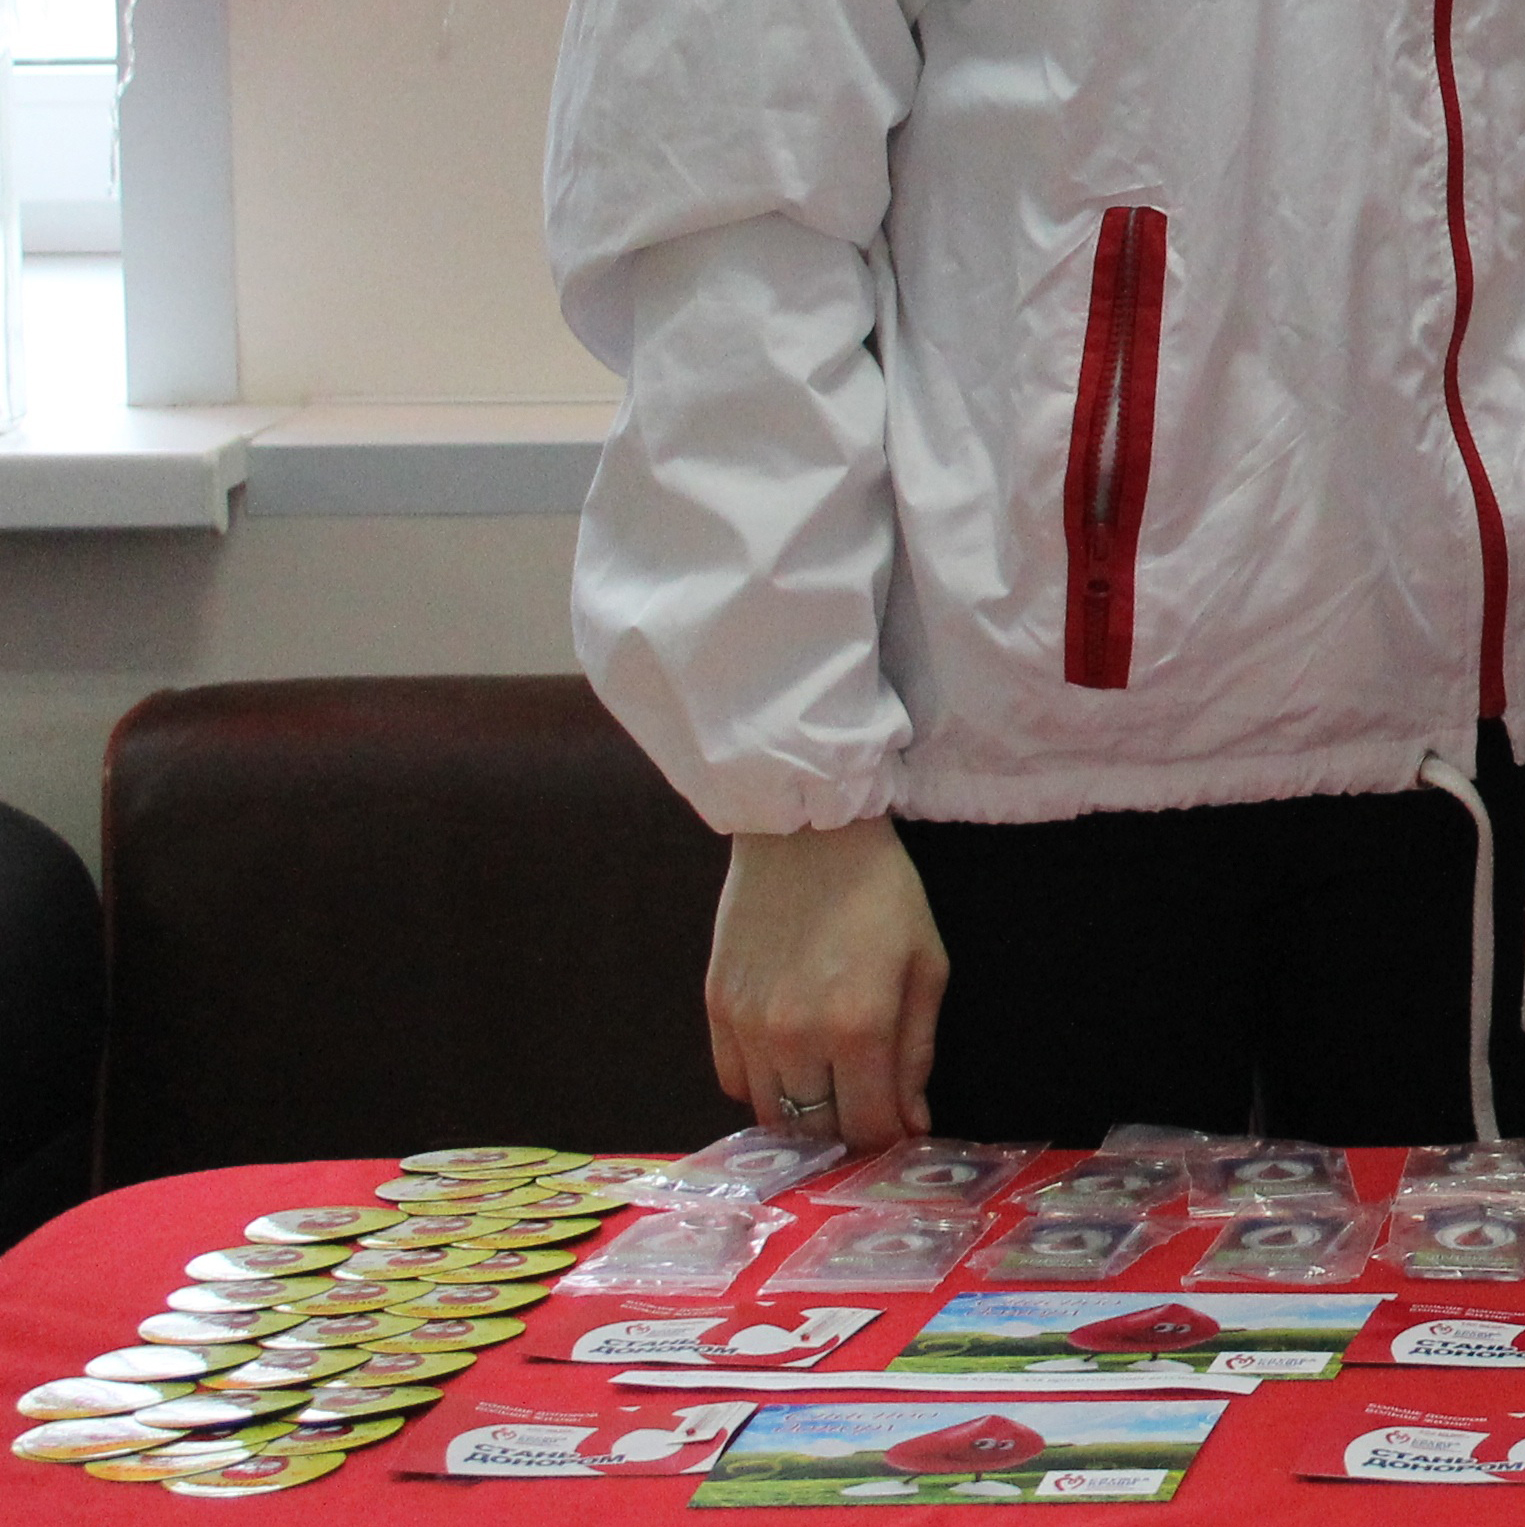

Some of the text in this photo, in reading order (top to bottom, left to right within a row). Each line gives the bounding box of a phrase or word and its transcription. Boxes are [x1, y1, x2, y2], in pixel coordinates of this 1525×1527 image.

[603, 1338, 701, 1347] СТАНЬ
[1416, 1339, 1518, 1351] СТАНЬ
[588, 1345, 739, 1355] ДОНОРОМ
[474, 1444, 581, 1458] СТАНЬ
[1372, 1448, 1478, 1463] СТАНЬ
[464, 1452, 626, 1467] ДОНОРОМ
[1363, 1457, 1524, 1473] ДОНОРОМ
